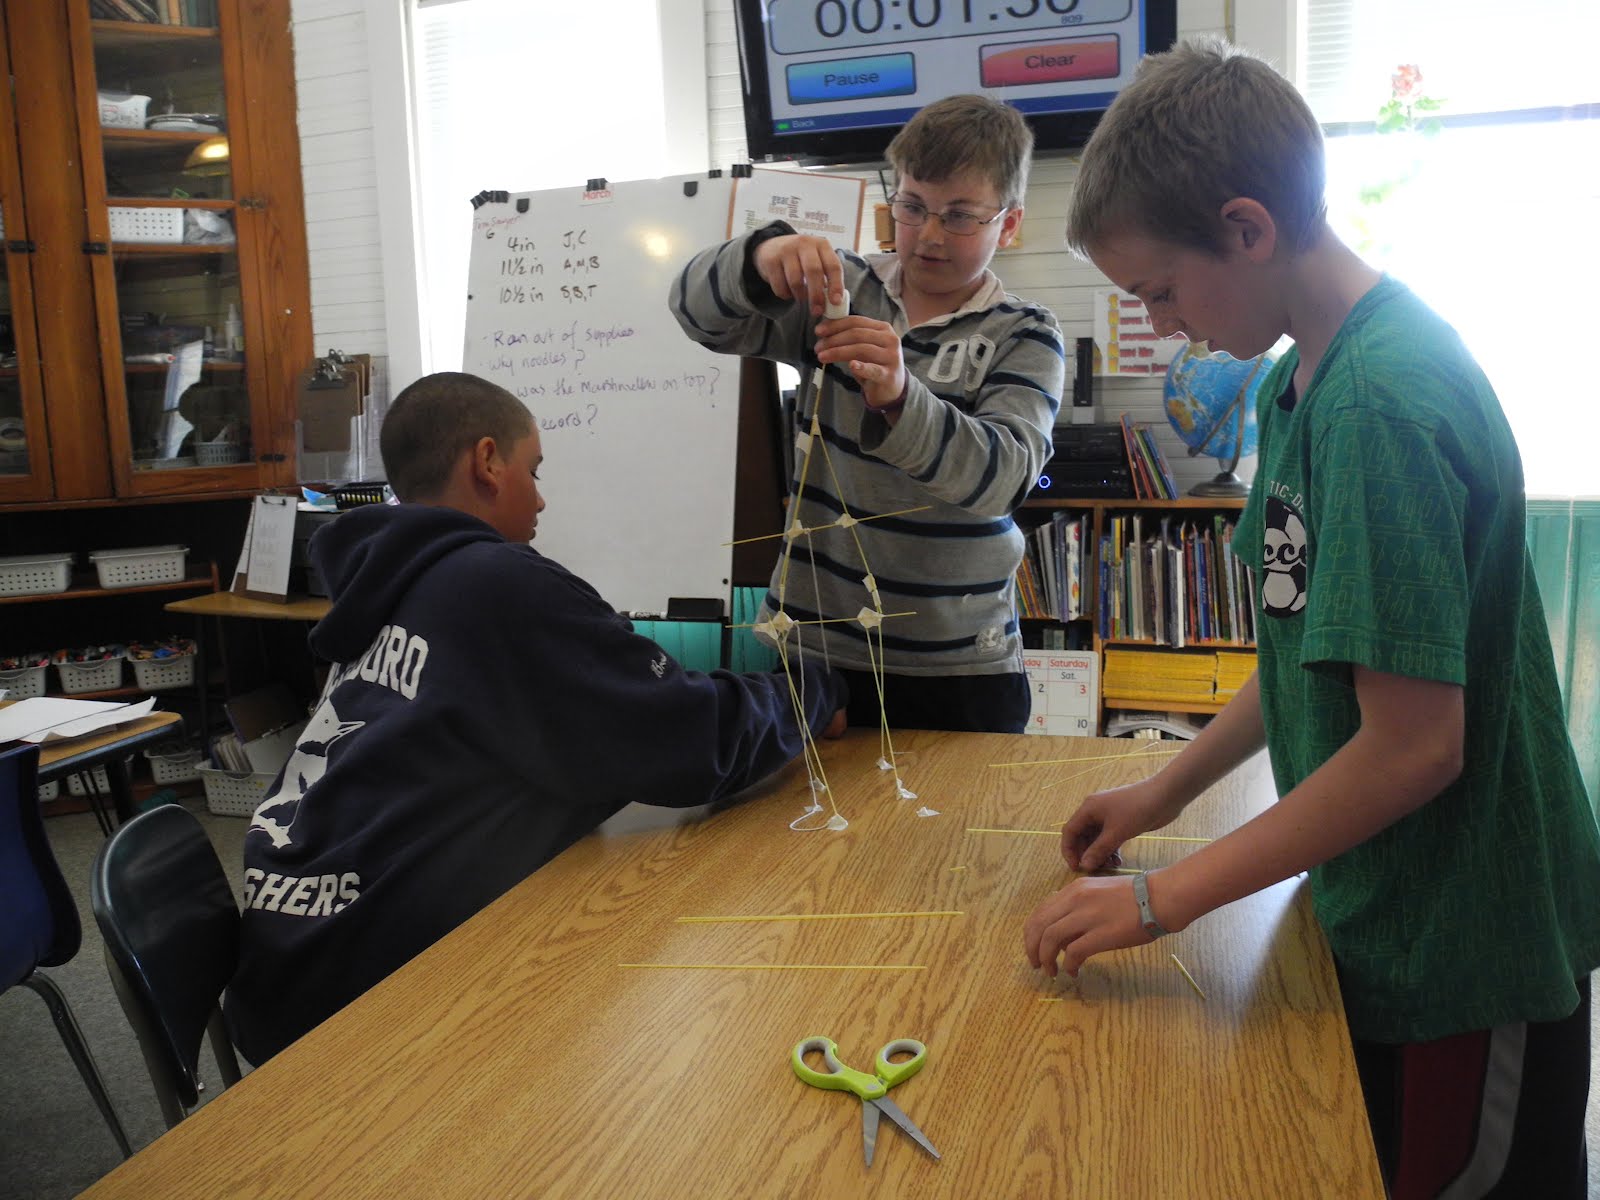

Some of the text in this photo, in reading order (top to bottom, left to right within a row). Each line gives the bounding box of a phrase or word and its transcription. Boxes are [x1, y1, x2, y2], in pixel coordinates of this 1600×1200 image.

[1024, 53, 1078, 69] Clear
[823, 71, 880, 87] Pause
[791, 119, 815, 129] Back
[494, 330, 529, 348] Ran
[561, 319, 578, 350] of
[927, 333, 996, 392] 09
[552, 377, 576, 397] the
[662, 378, 679, 391] on
[1048, 659, 1089, 670] Saturday
[1060, 671, 1078, 680] Sat.
[1038, 683, 1087, 695] 2 3
[1036, 715, 1088, 729] 9 10
